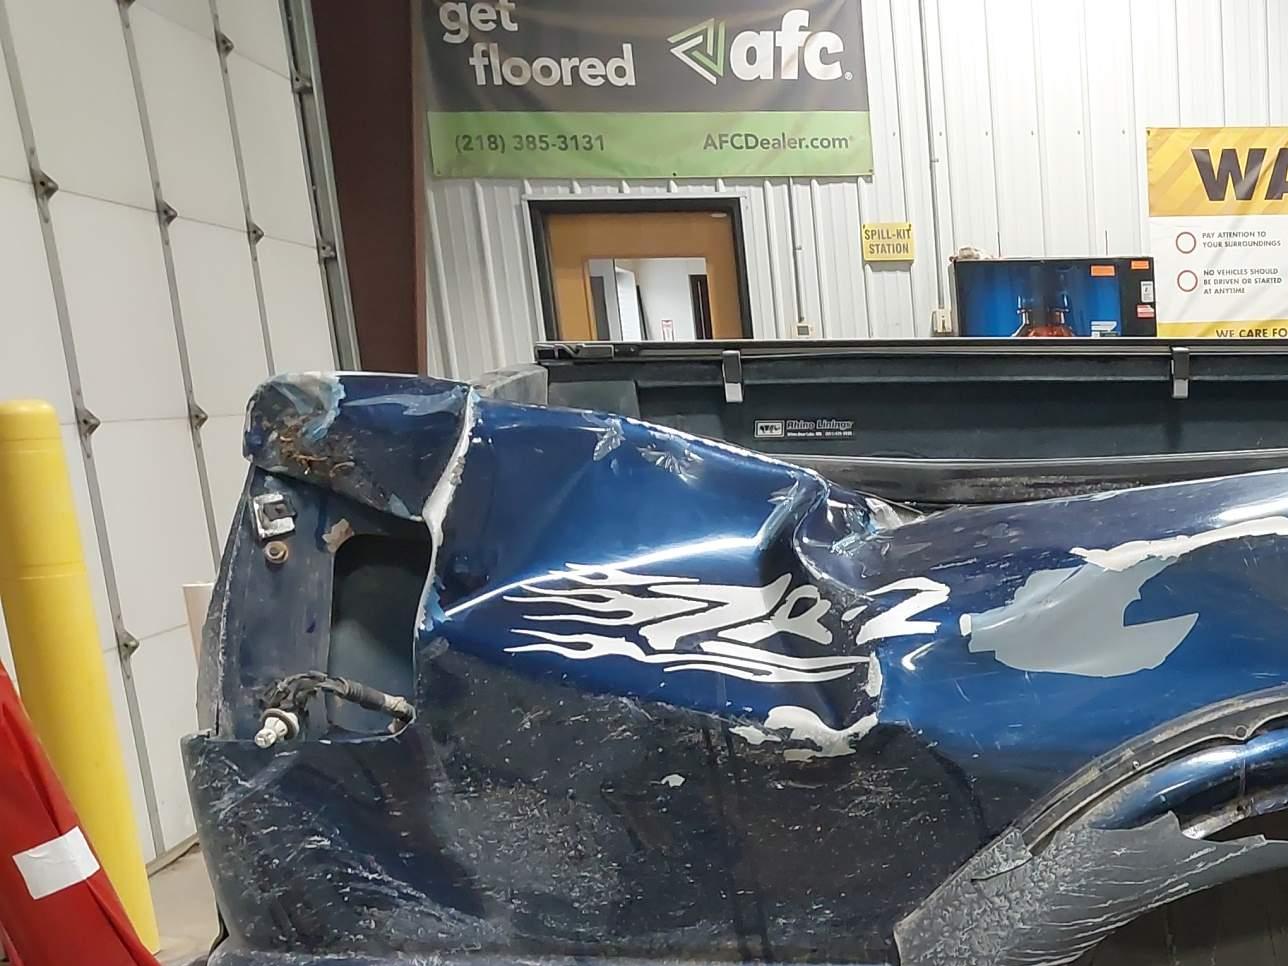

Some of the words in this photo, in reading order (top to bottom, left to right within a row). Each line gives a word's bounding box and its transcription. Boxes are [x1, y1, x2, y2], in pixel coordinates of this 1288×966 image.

[439, 1, 519, 43] get
[468, 43, 637, 87] floored
[455, 134, 506, 153] (218)
[513, 133, 605, 152] 385-3131
[703, 133, 849, 151] AFCDealer.com
[865, 229, 911, 240] SPILL-KIT
[869, 243, 909, 254] STATION
[1216, 329, 1235, 337] WE
[1239, 328, 1268, 337] CARE
